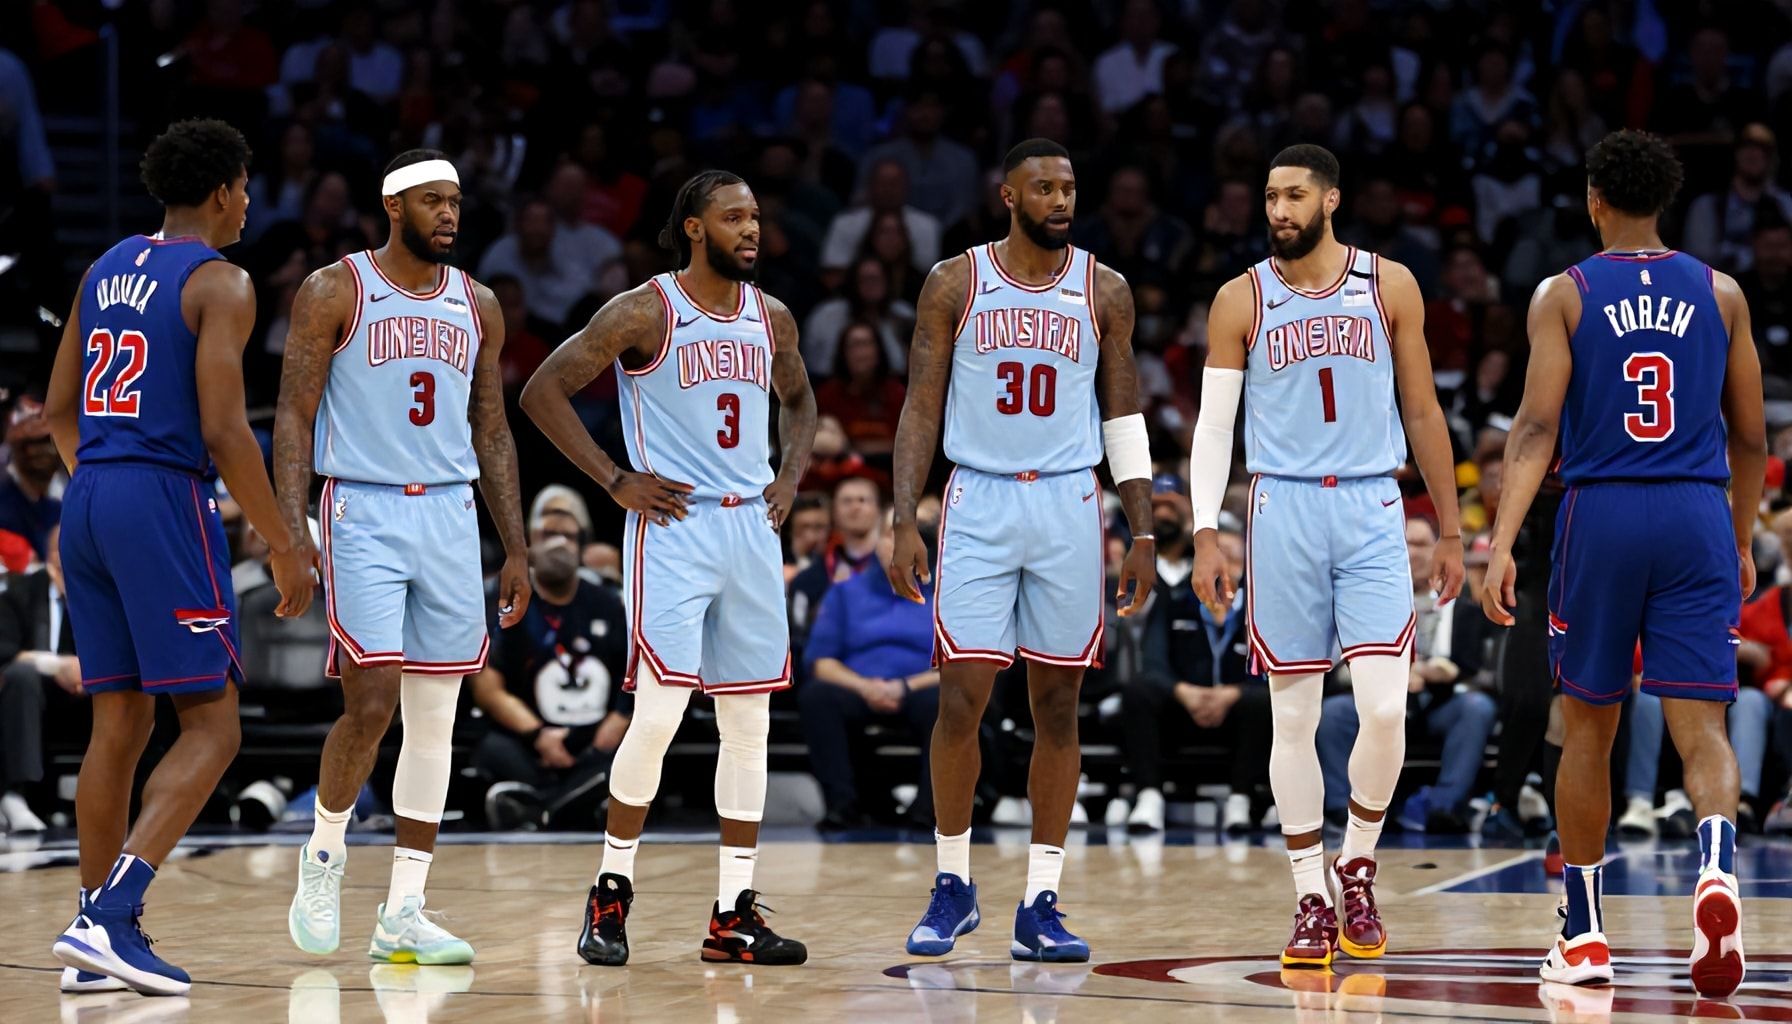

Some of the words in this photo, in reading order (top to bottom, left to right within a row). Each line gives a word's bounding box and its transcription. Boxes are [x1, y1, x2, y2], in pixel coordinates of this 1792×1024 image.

[84, 328, 148, 417] 22
[409, 371, 436, 426] 3
[996, 361, 1057, 417] 30
[1318, 367, 1336, 423] 1
[1623, 352, 1676, 442] 3
[717, 393, 740, 449] 3
